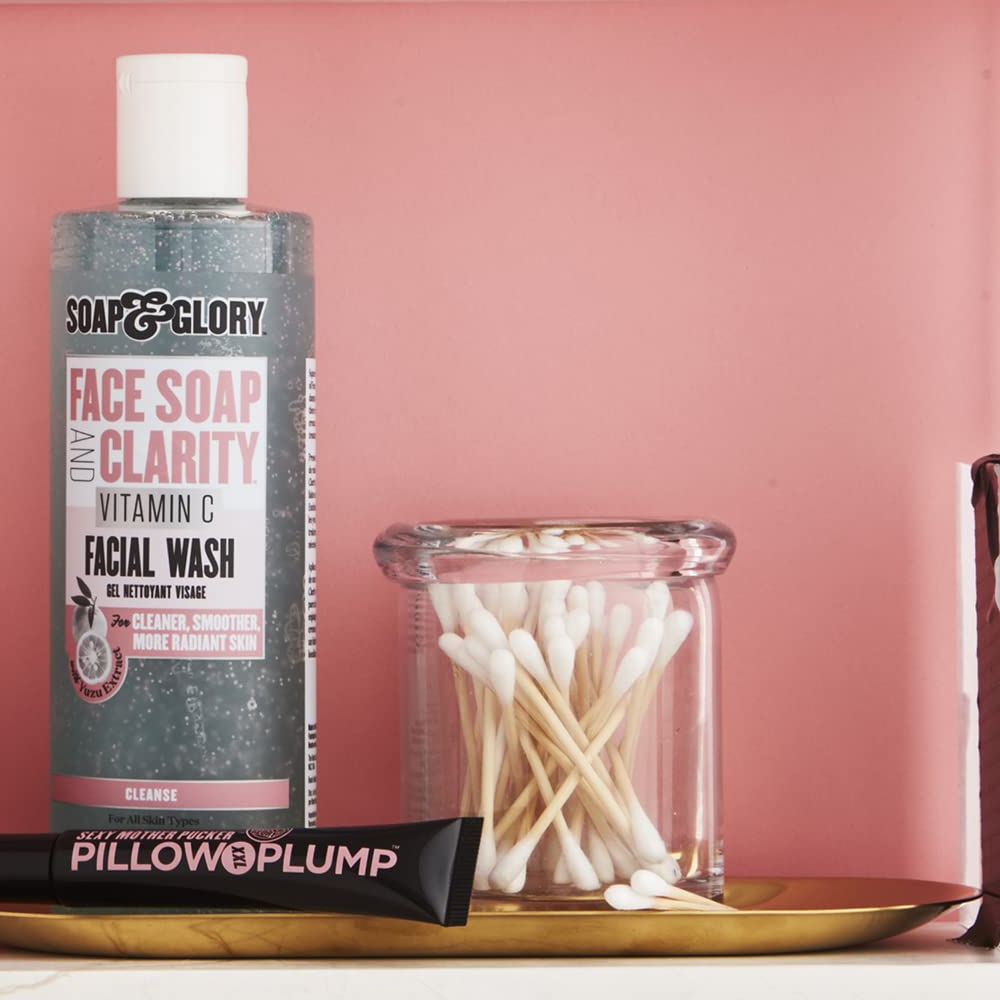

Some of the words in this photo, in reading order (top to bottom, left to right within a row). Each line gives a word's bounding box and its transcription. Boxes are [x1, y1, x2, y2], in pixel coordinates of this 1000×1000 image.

[66, 289, 264, 341] SOAP&GLORY
[70, 367, 145, 422] FACE
[155, 368, 261, 424] SOAP
[69, 427, 95, 482] AND
[100, 428, 259, 485] CLARITY
[100, 493, 191, 523] VITAMIN
[202, 494, 214, 523] C
[85, 536, 155, 577] FACIAL
[166, 537, 235, 578] WASH
[107, 584, 120, 598] GEL
[123, 584, 172, 599] NETTOYANT
[175, 585, 206, 599] VISAGE
[111, 614, 131, 628] For
[132, 613, 190, 633] CLEANER,
[192, 614, 261, 633] SMOOTHER,
[133, 633, 169, 650] MORE
[171, 634, 227, 651] RADIANT
[229, 634, 257, 651] SKIN
[79, 680, 103, 698] Yuzu
[103, 647, 122, 693] Extract
[125, 787, 178, 802] CLEANSE
[108, 814, 126, 825] For
[127, 814, 141, 825] All
[142, 814, 165, 826] Skin
[166, 815, 200, 828] Types
[76, 831, 116, 840] SEXY
[115, 831, 175, 840] MOTHER
[177, 831, 236, 841] PUCKER
[71, 842, 228, 871] PILLOW
[232, 846, 247, 869] XXL
